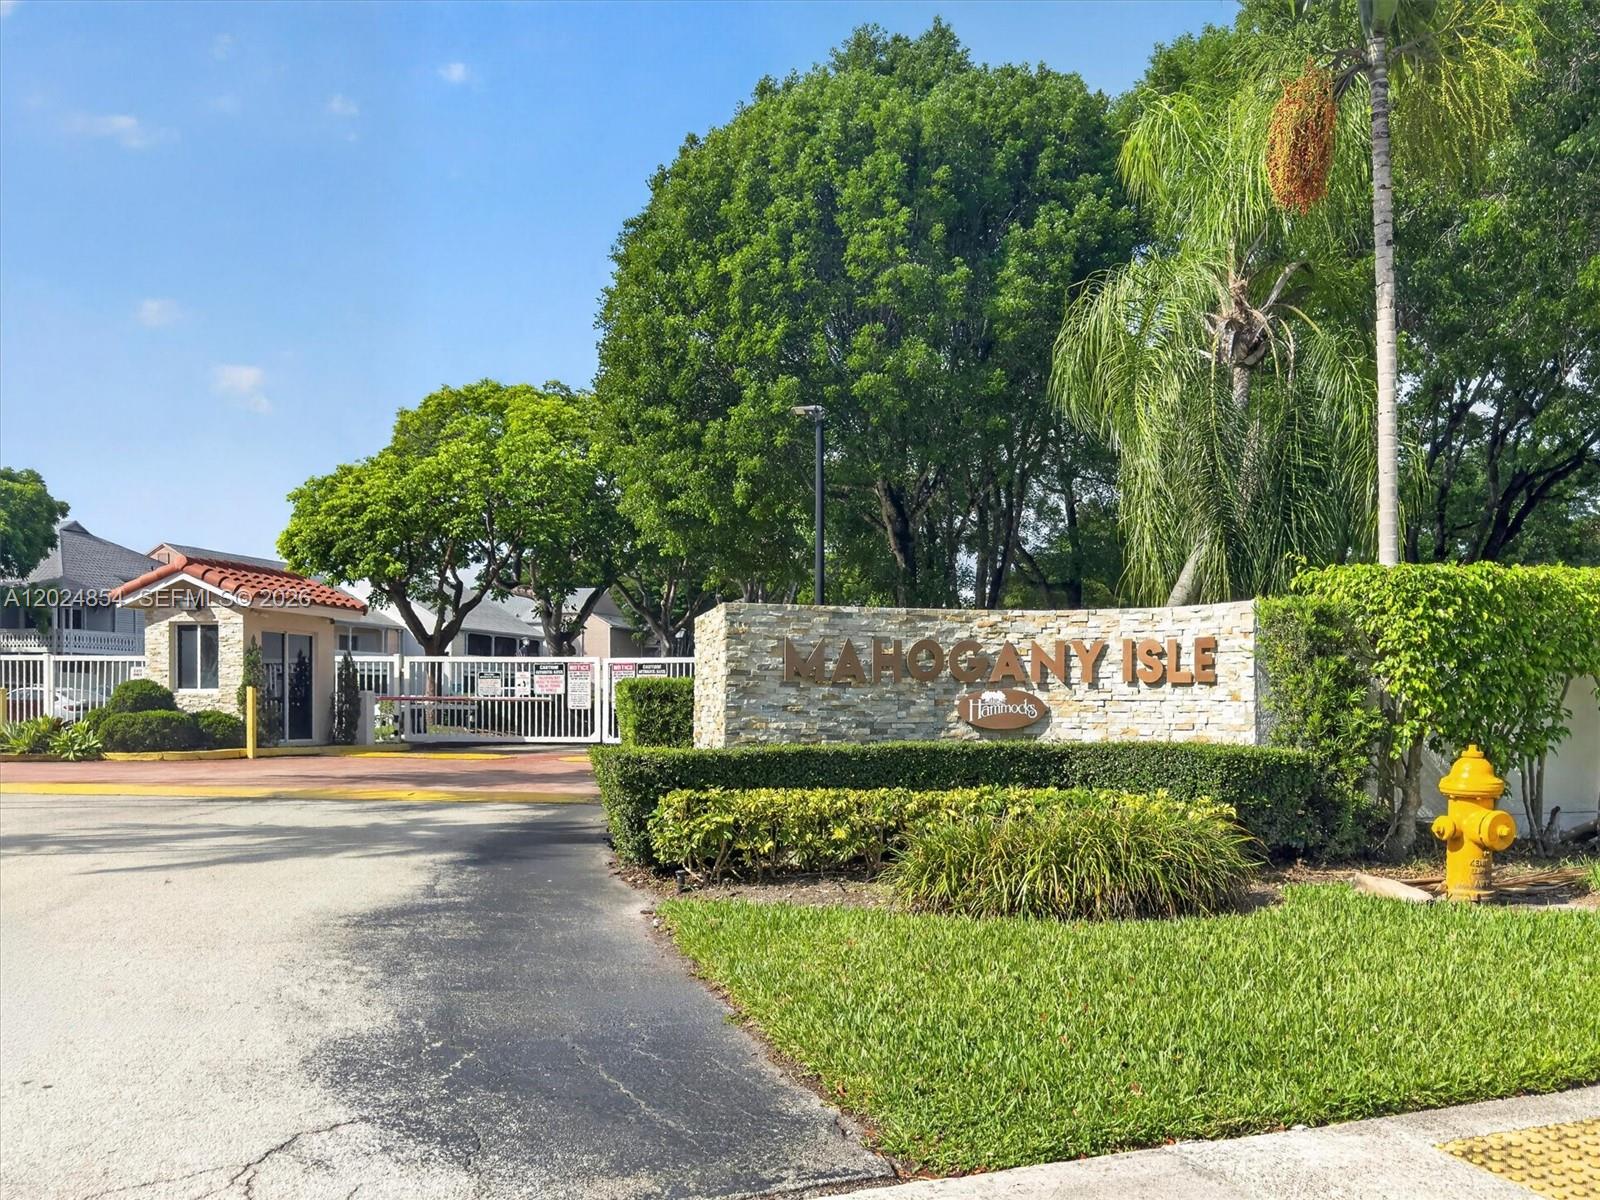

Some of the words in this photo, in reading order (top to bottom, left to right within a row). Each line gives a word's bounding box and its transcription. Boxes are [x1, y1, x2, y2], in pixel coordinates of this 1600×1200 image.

[783, 636, 1105, 684] MAHOGANY
[1122, 636, 1216, 684] ISLE
[968, 698, 1038, 722] Hammocks
